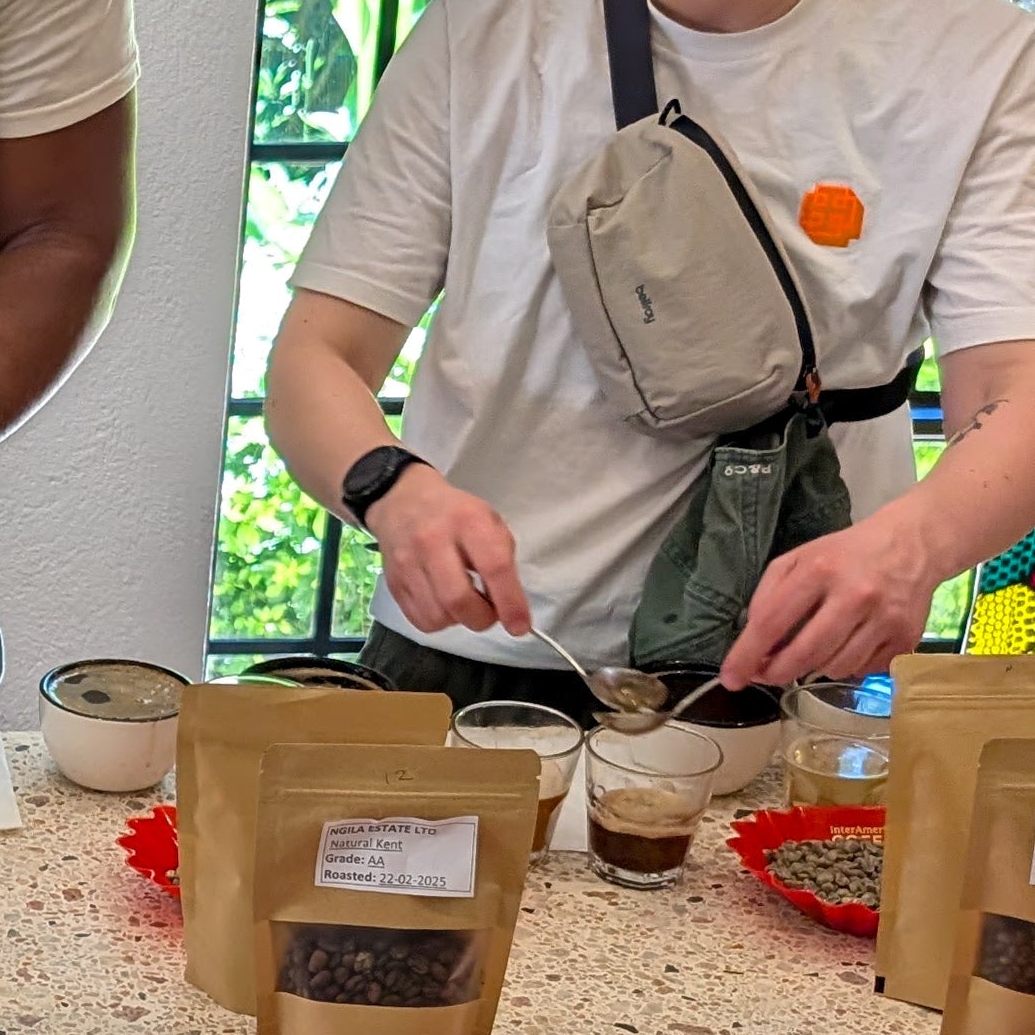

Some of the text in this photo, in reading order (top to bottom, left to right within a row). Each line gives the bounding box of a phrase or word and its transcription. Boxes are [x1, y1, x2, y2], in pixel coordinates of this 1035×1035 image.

[330, 824, 437, 836] NGILA ESTATE LTD
[829, 825, 883, 834] InterAmer
[330, 837, 403, 851] Natural Kent
[325, 853, 385, 867] Grade: AA
[324, 869, 447, 888] Roasted: 22-02-2025
